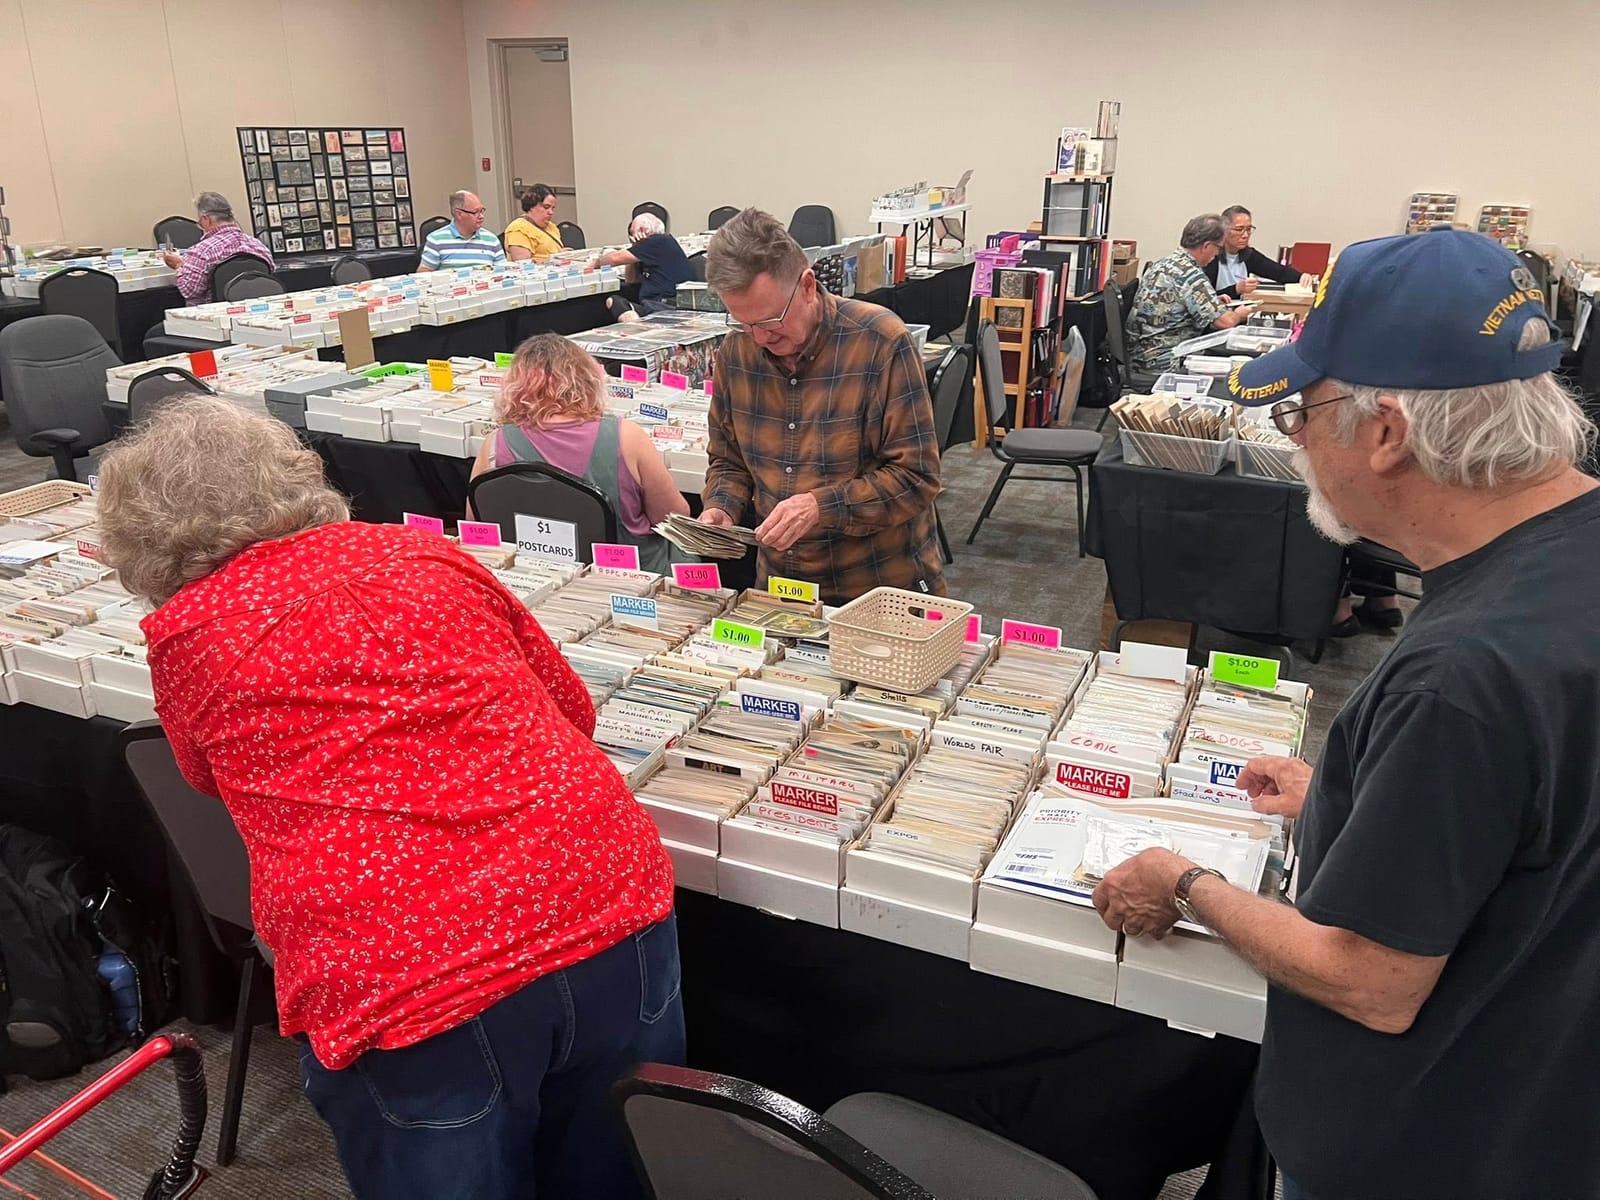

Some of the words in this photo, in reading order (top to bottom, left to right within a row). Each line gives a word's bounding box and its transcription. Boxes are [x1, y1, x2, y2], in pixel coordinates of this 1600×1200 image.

[1479, 291, 1527, 335] VIETNAM
[1240, 377, 1288, 400] VETERAN
[641, 403, 667, 416] MARKER
[654, 426, 683, 437] MARKER
[469, 527, 489, 535] $1.00
[537, 521, 552, 534] $1
[518, 540, 574, 558] POSTCARDS
[684, 570, 708, 579] $1.00
[777, 584, 803, 597] $1.00
[613, 596, 655, 611] MARKER
[722, 628, 750, 644] $1.00
[1014, 629, 1046, 643] $1.00
[1228, 657, 1259, 669] $1.00
[743, 695, 797, 714] MARKER
[880, 691, 907, 703] Shells
[618, 709, 672, 724] MARINELAND
[748, 707, 771, 716] PLEASE
[596, 723, 631, 733] KNOTT'S
[634, 730, 662, 739] BERRY
[619, 735, 643, 743] FARM
[1070, 735, 1119, 754] COMIC
[1219, 733, 1264, 752] DOGS
[943, 736, 976, 751] WORLDS
[981, 743, 1005, 758] FAIR
[788, 770, 856, 791] MILITARY
[1060, 764, 1126, 790] MARKER
[773, 784, 836, 807] MARKER
[1063, 780, 1091, 792] PLEASE
[1092, 786, 1108, 795] USE
[1109, 789, 1121, 798] ME
[774, 796, 798, 806] PLEASE
[798, 801, 812, 809] FILE
[813, 804, 836, 813] BEHIND
[1034, 816, 1076, 824] EXPRESS
[886, 829, 919, 841] EXPOS
